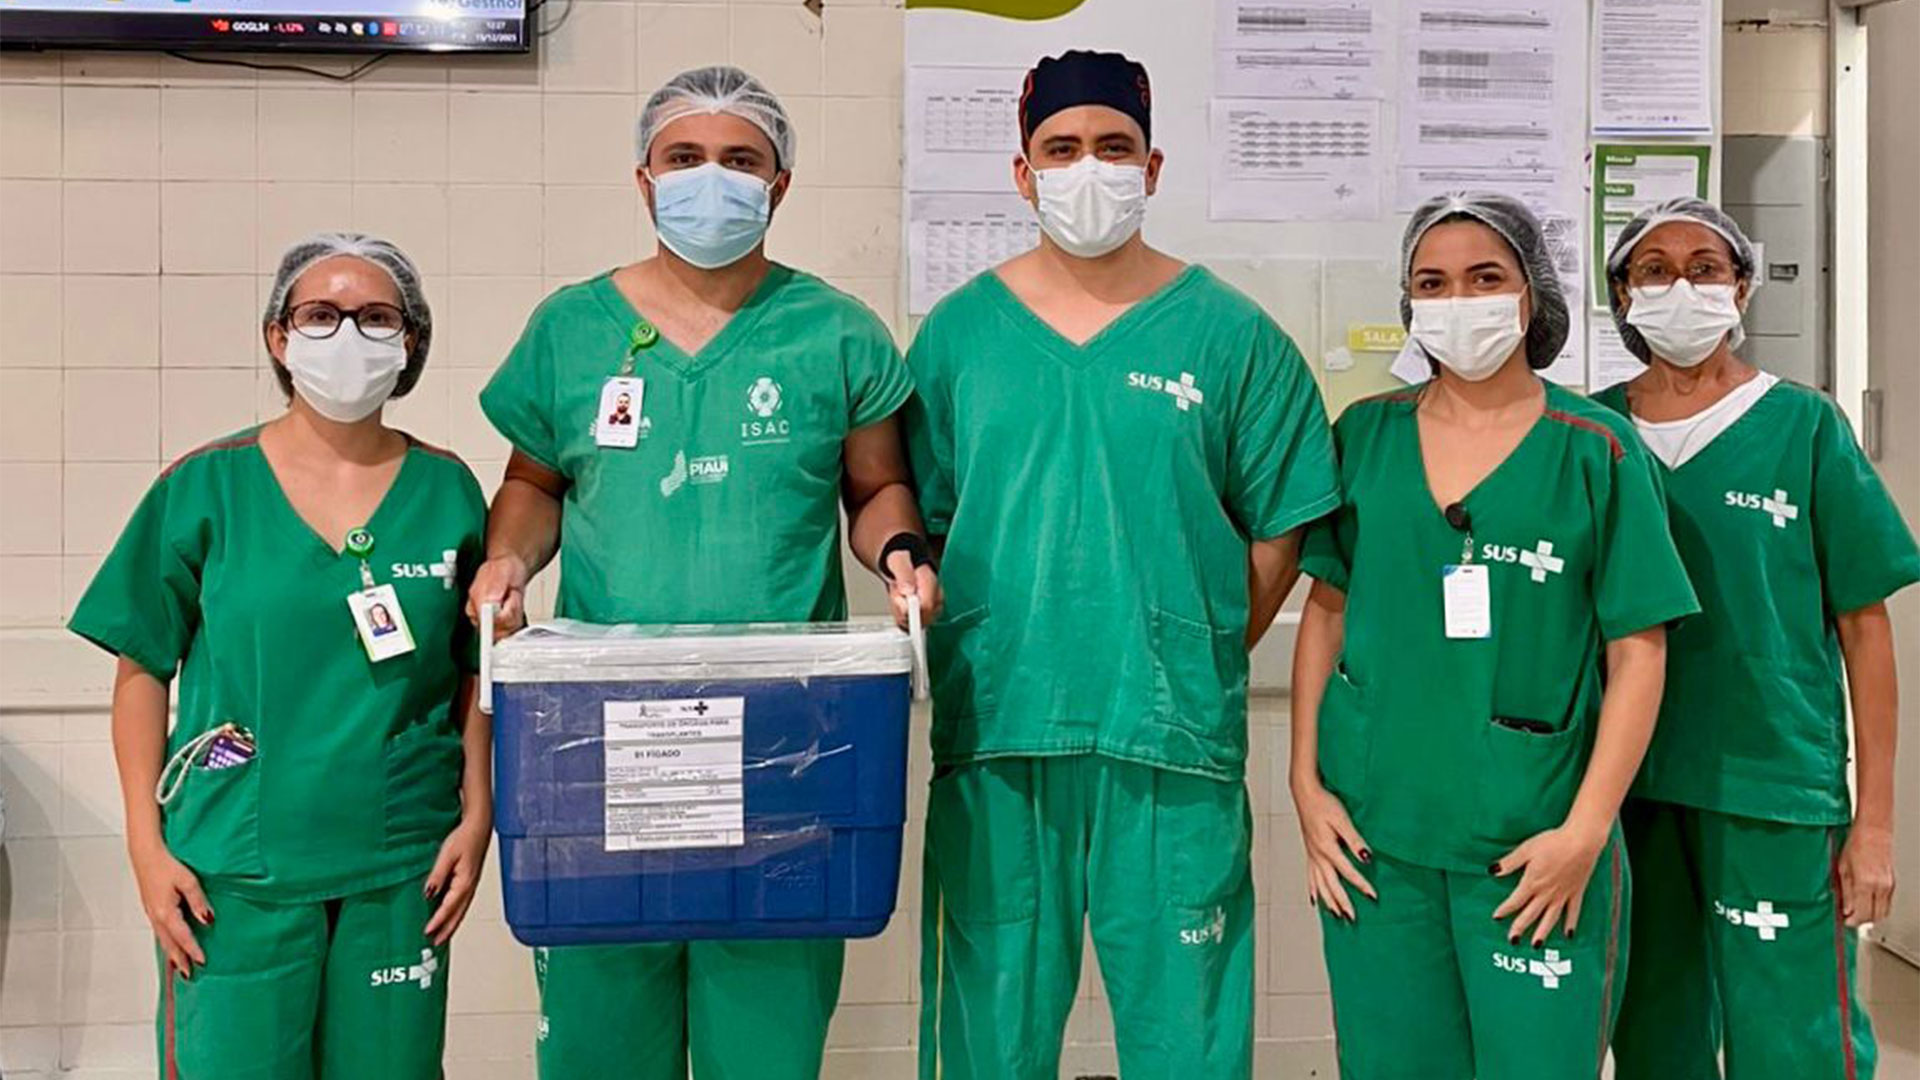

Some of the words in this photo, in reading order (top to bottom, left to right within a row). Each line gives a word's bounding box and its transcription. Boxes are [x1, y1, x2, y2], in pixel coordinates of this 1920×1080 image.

[1128, 371, 1163, 390] SUS
[742, 421, 790, 438] ISAC
[1725, 490, 1761, 509] SUS
[1482, 543, 1518, 563] SUS
[391, 563, 428, 578] SUS
[1493, 952, 1528, 973] SUS
[370, 967, 407, 986] SUS
